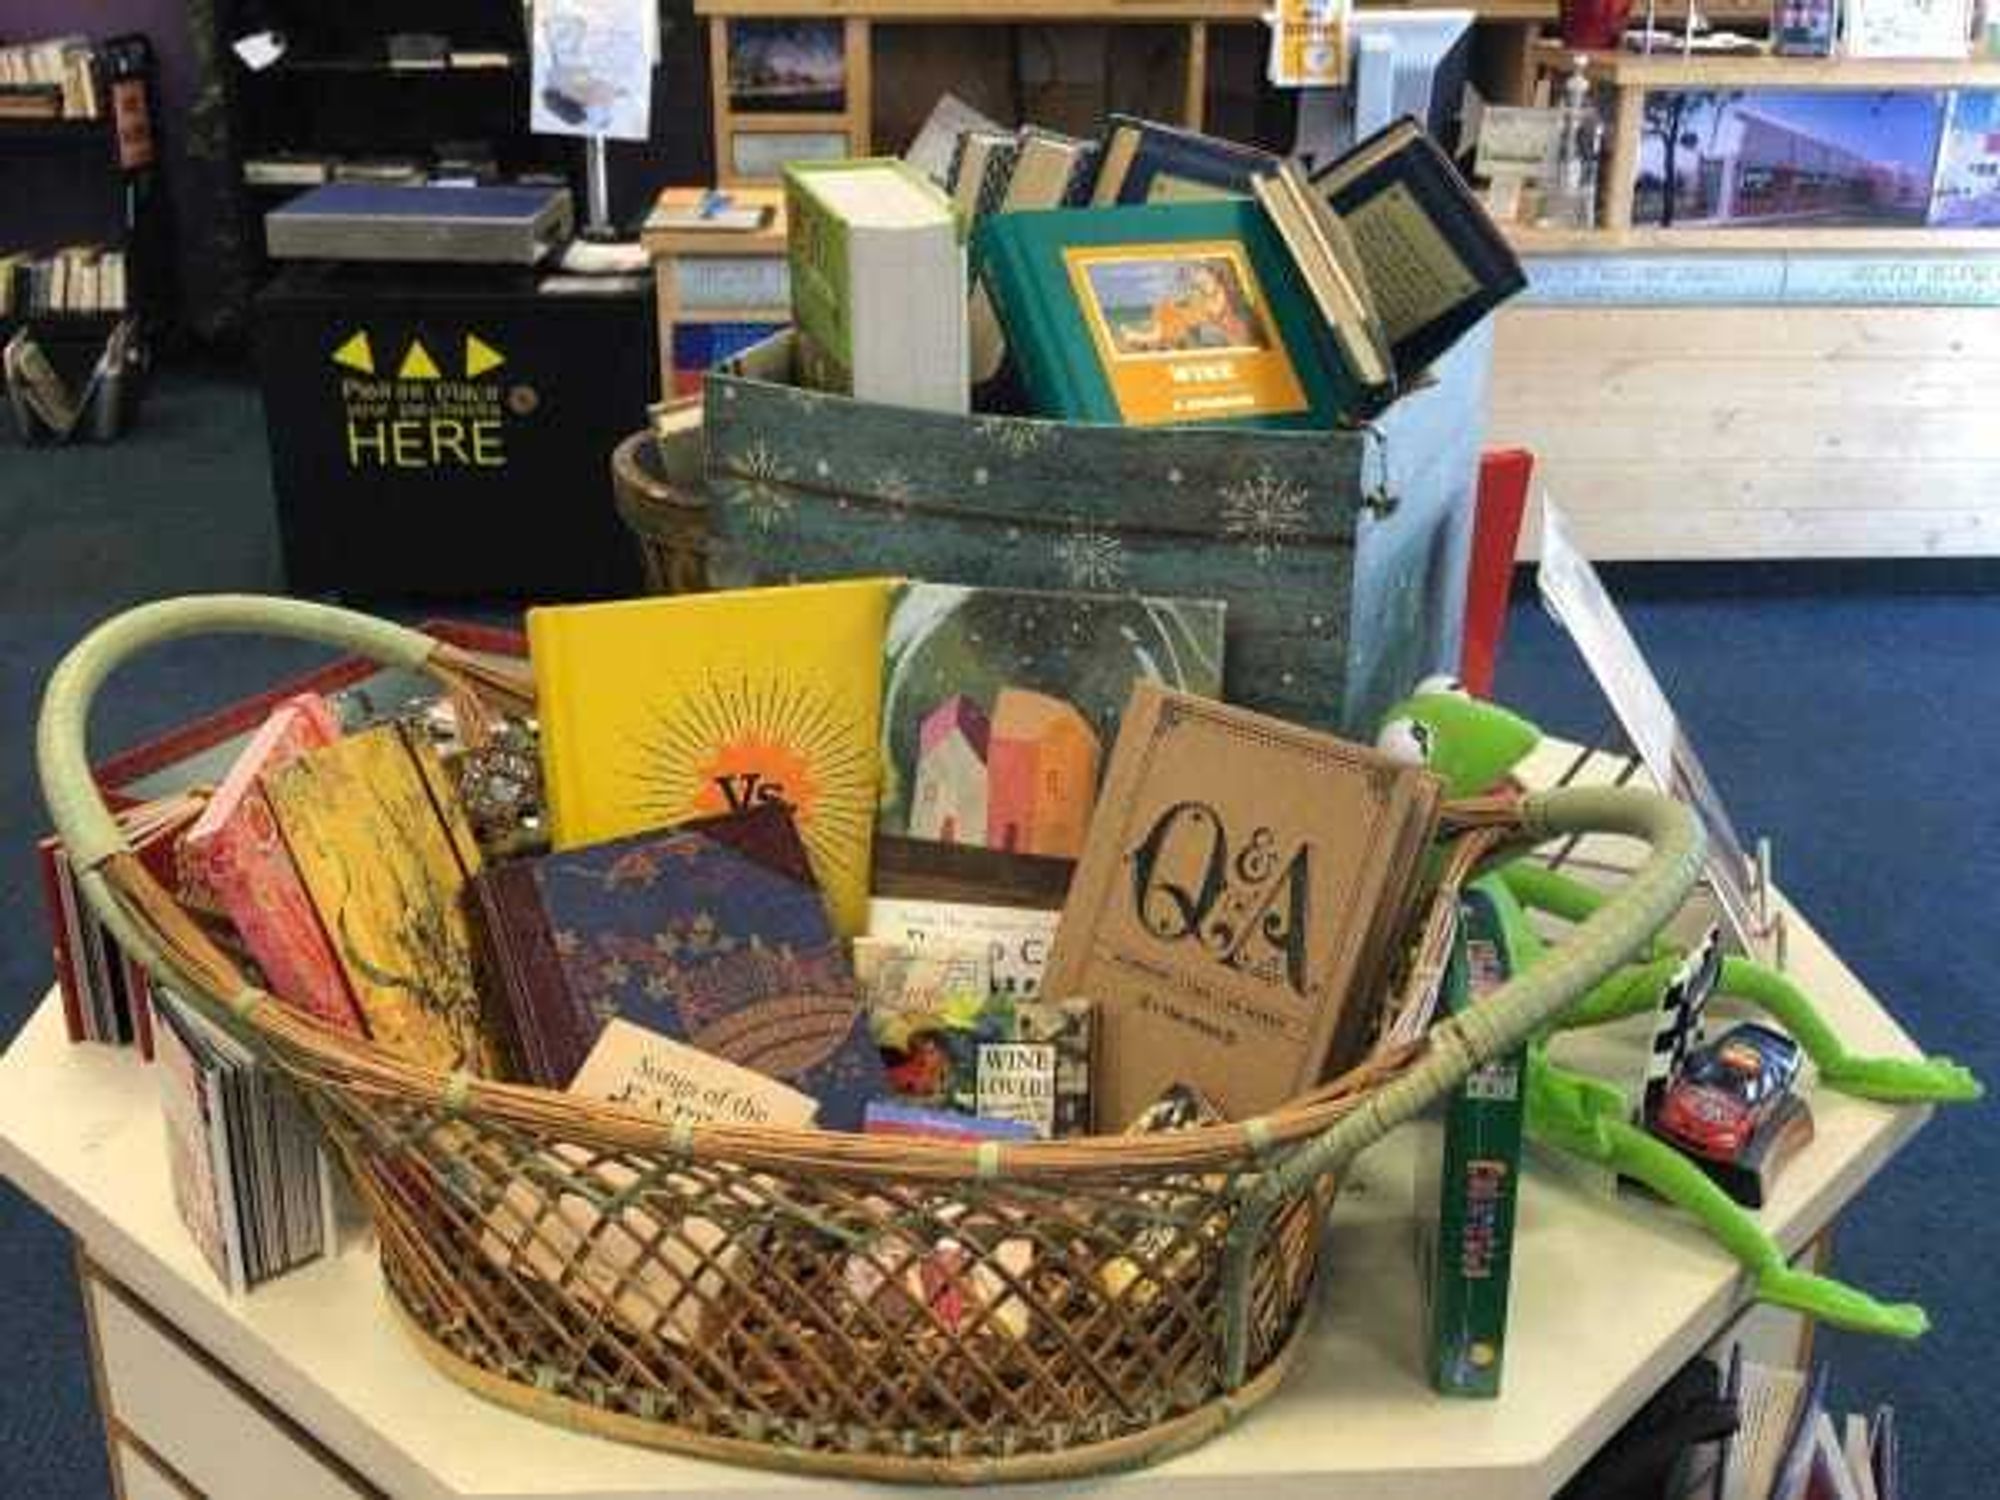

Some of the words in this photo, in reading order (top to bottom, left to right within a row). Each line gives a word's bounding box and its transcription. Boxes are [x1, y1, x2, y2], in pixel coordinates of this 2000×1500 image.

[348, 419, 507, 467] HERE
[986, 1049, 1050, 1071] WINE
[702, 1090, 731, 1110] of
